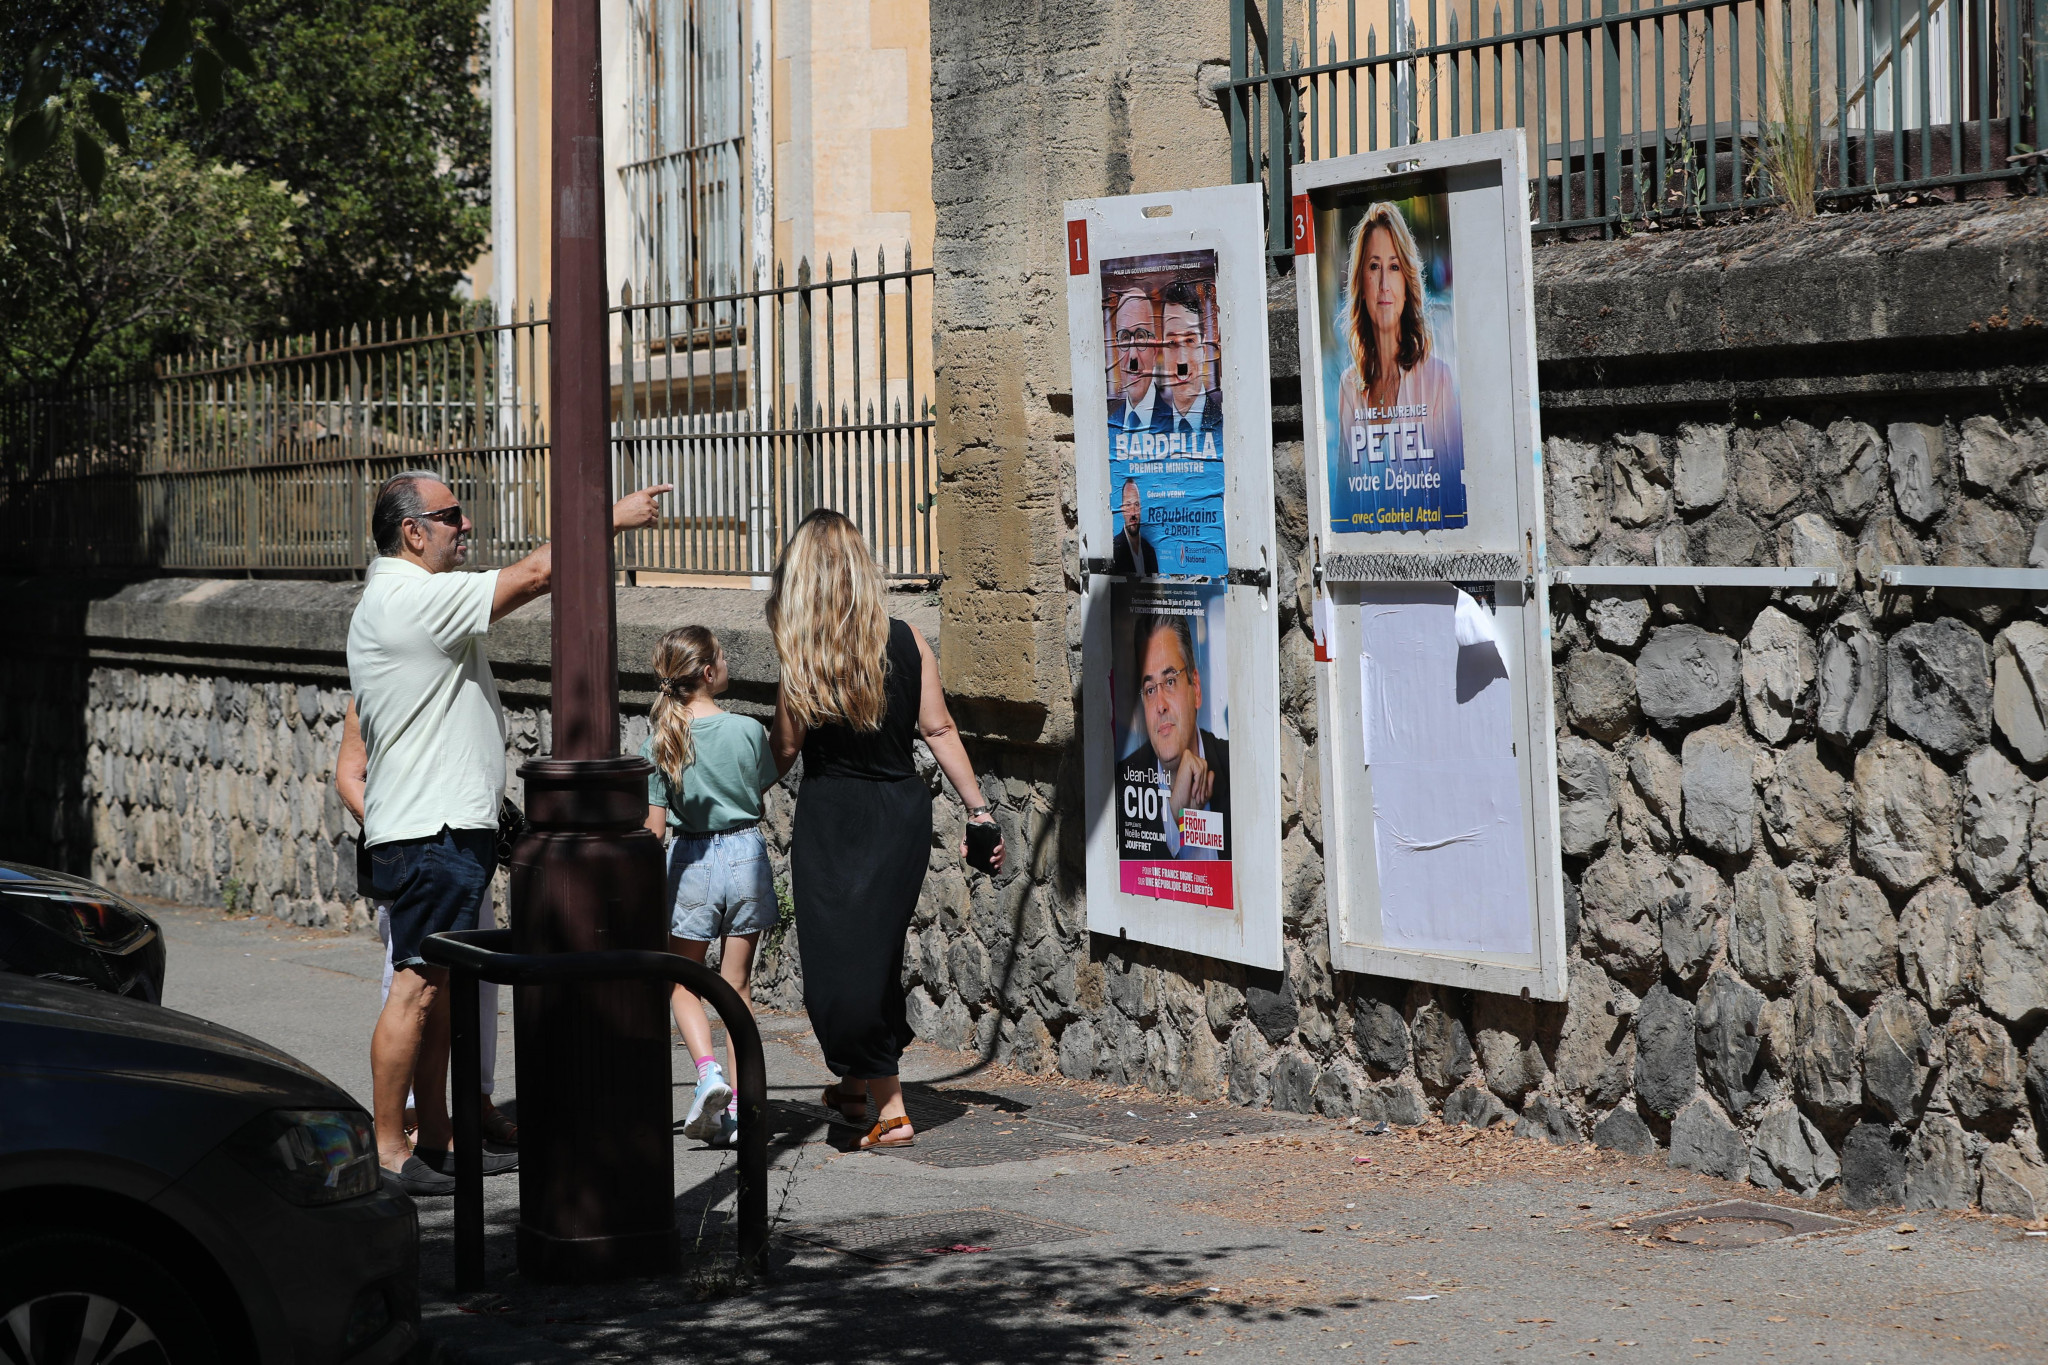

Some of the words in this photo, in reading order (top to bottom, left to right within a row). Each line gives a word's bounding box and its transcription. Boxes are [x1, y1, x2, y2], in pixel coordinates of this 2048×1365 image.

[1295, 214, 1305, 240] 3
[1075, 238, 1082, 261] 1
[1131, 265, 1161, 274] GOUVERNEMENT
[1354, 404, 1427, 421] ANNE-LAURENCE
[1115, 432, 1218, 460] BARDELLA
[1350, 422, 1435, 464] PETEL
[1129, 462, 1164, 473] PREMIER
[1166, 462, 1204, 473] MINISTRE
[1348, 472, 1380, 492] votre
[1385, 466, 1441, 497] Députée
[1167, 490, 1186, 498] VERNY
[1148, 506, 1217, 527] Républicains
[1352, 511, 1374, 524] avec
[1376, 506, 1413, 524] Gabriel
[1415, 506, 1441, 523] Attal
[1164, 525, 1170, 535] à
[1171, 525, 1201, 536] DROITE
[1185, 555, 1207, 563] National
[1123, 765, 1171, 786] Jean-David
[1123, 785, 1172, 822] CIOT
[1185, 817, 1207, 832] FRONT
[1141, 830, 1167, 842] CICCOLINI
[1185, 830, 1223, 848] POPULAIRE
[1124, 839, 1152, 852] JOUFFRET
[1142, 866, 1152, 875] POUR
[1152, 866, 1161, 877] UNE
[1161, 868, 1179, 880] FRANCE
[1179, 870, 1194, 882] DIGNE
[1137, 876, 1145, 886] SUR
[1145, 876, 1155, 887] UNE
[1155, 876, 1182, 892] RÉPUBLIQUE
[1182, 882, 1191, 893] DES
[1191, 883, 1214, 896] LIBERTÉS
